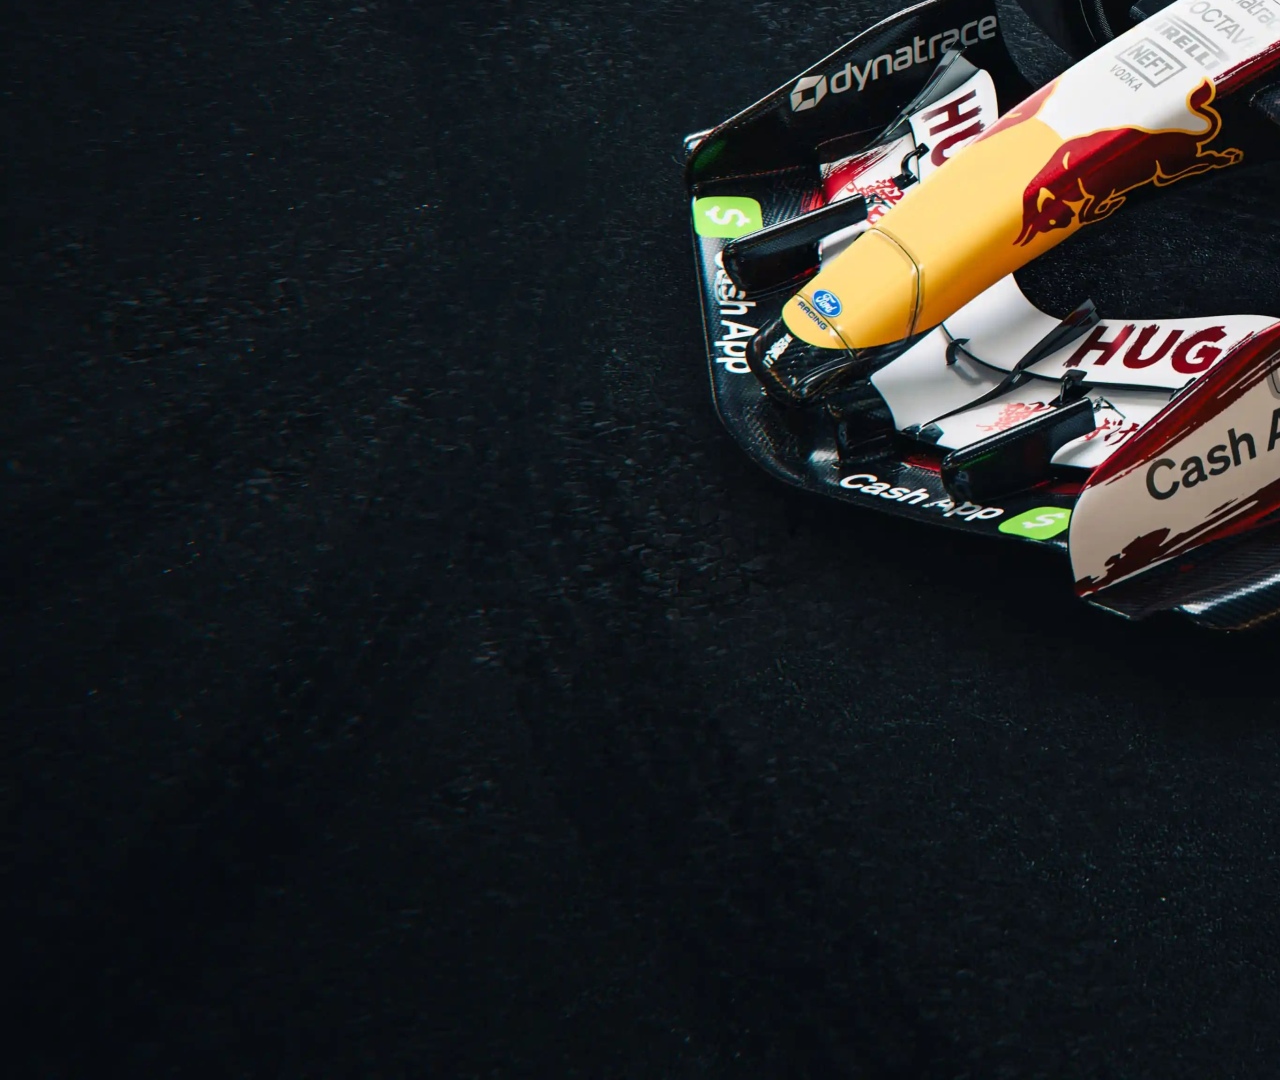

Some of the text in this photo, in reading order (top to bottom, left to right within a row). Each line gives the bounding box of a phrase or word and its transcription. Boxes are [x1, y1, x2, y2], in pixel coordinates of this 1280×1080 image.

[1189, 1, 1256, 52] OCTAV
[830, 15, 998, 94] dynatrace
[1109, 64, 1144, 92] VODKA
[1127, 45, 1174, 77] NEFT
[920, 88, 985, 168] HU
[797, 301, 828, 331] RACING
[816, 293, 838, 314] Ford
[714, 320, 760, 374] App
[1062, 323, 1228, 375] HUG
[1146, 428, 1257, 501] Cash
[839, 472, 927, 508] Cash
[927, 496, 1005, 522] App
